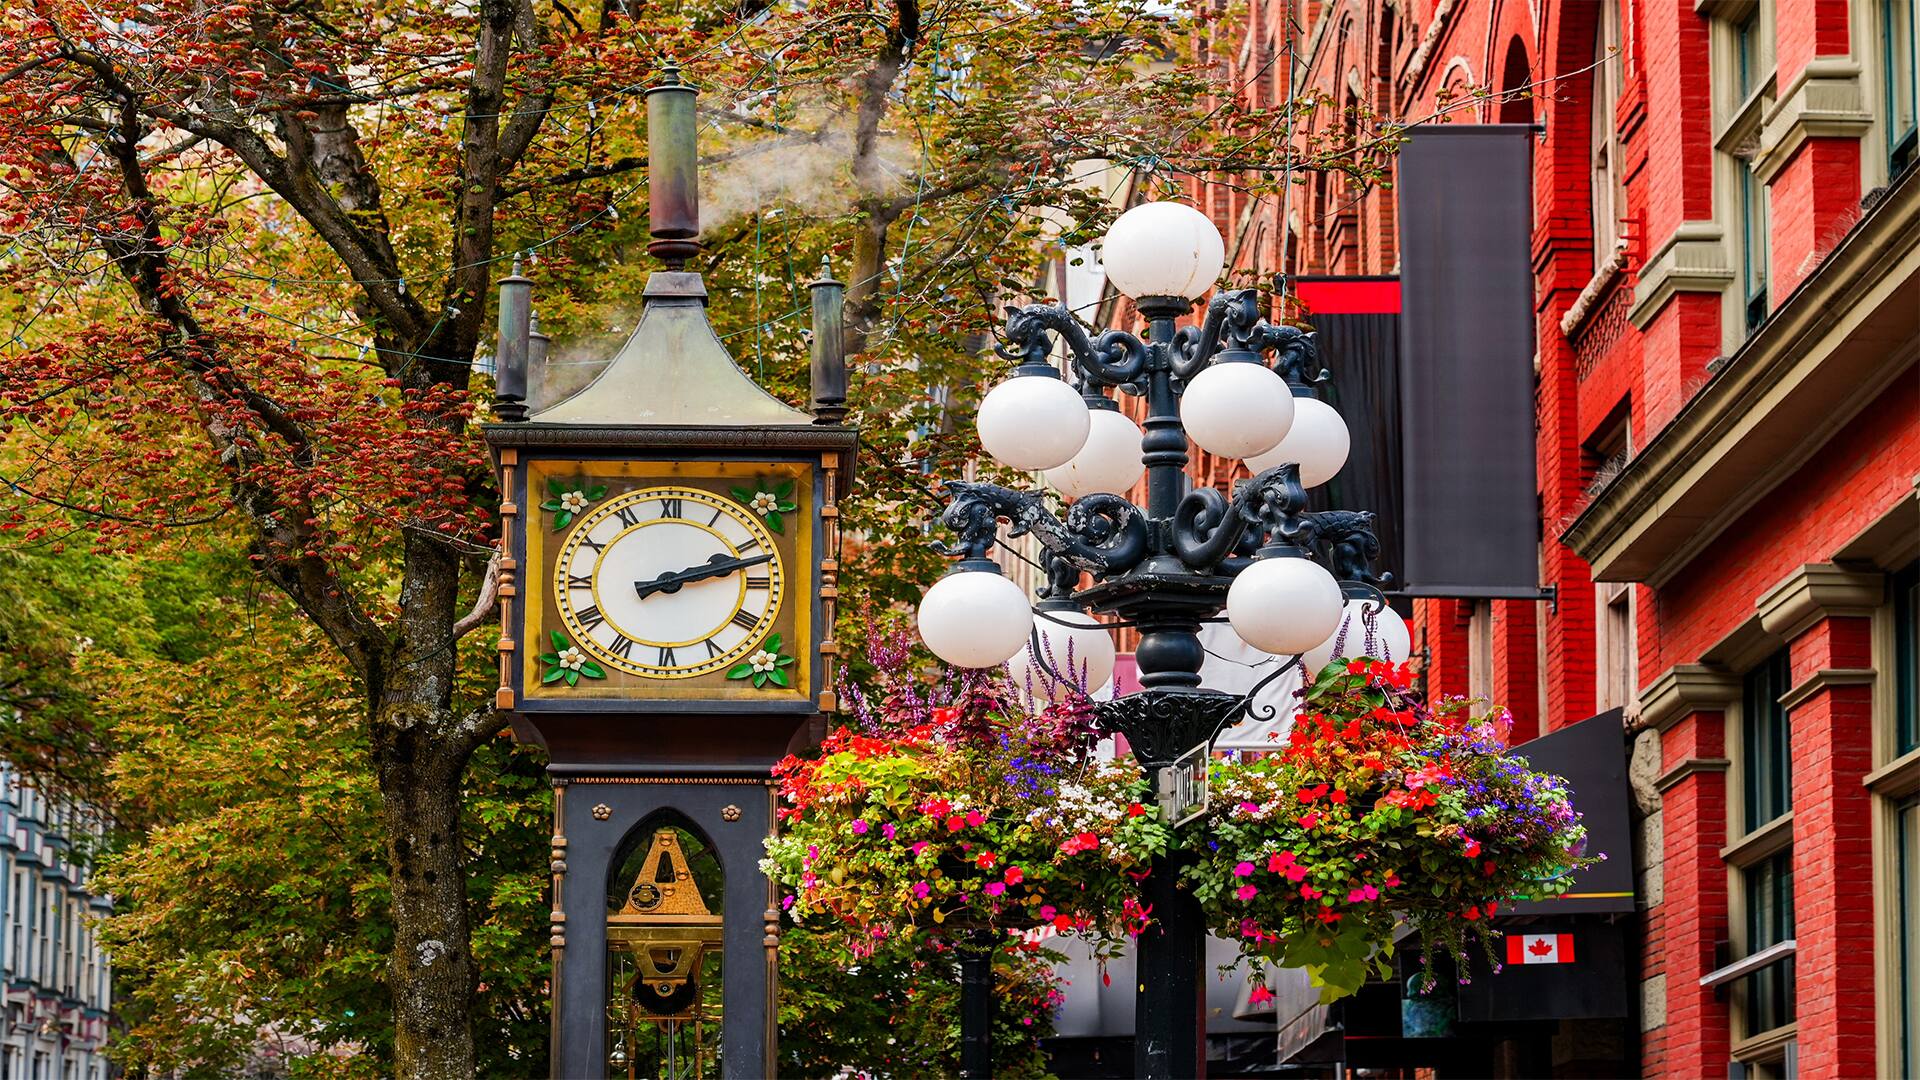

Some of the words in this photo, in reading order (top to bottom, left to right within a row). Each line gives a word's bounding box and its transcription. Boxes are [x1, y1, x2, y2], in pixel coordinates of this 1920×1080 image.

[614, 506, 640, 529] XI
[660, 499, 682, 519] XII
[579, 535, 606, 554] X
[735, 538, 760, 553] II
[568, 574, 592, 589] IX
[746, 577, 770, 589] III
[575, 604, 605, 632] VIII
[608, 633, 633, 659] VII
[705, 638, 725, 658] V
[658, 647, 677, 667] VI
